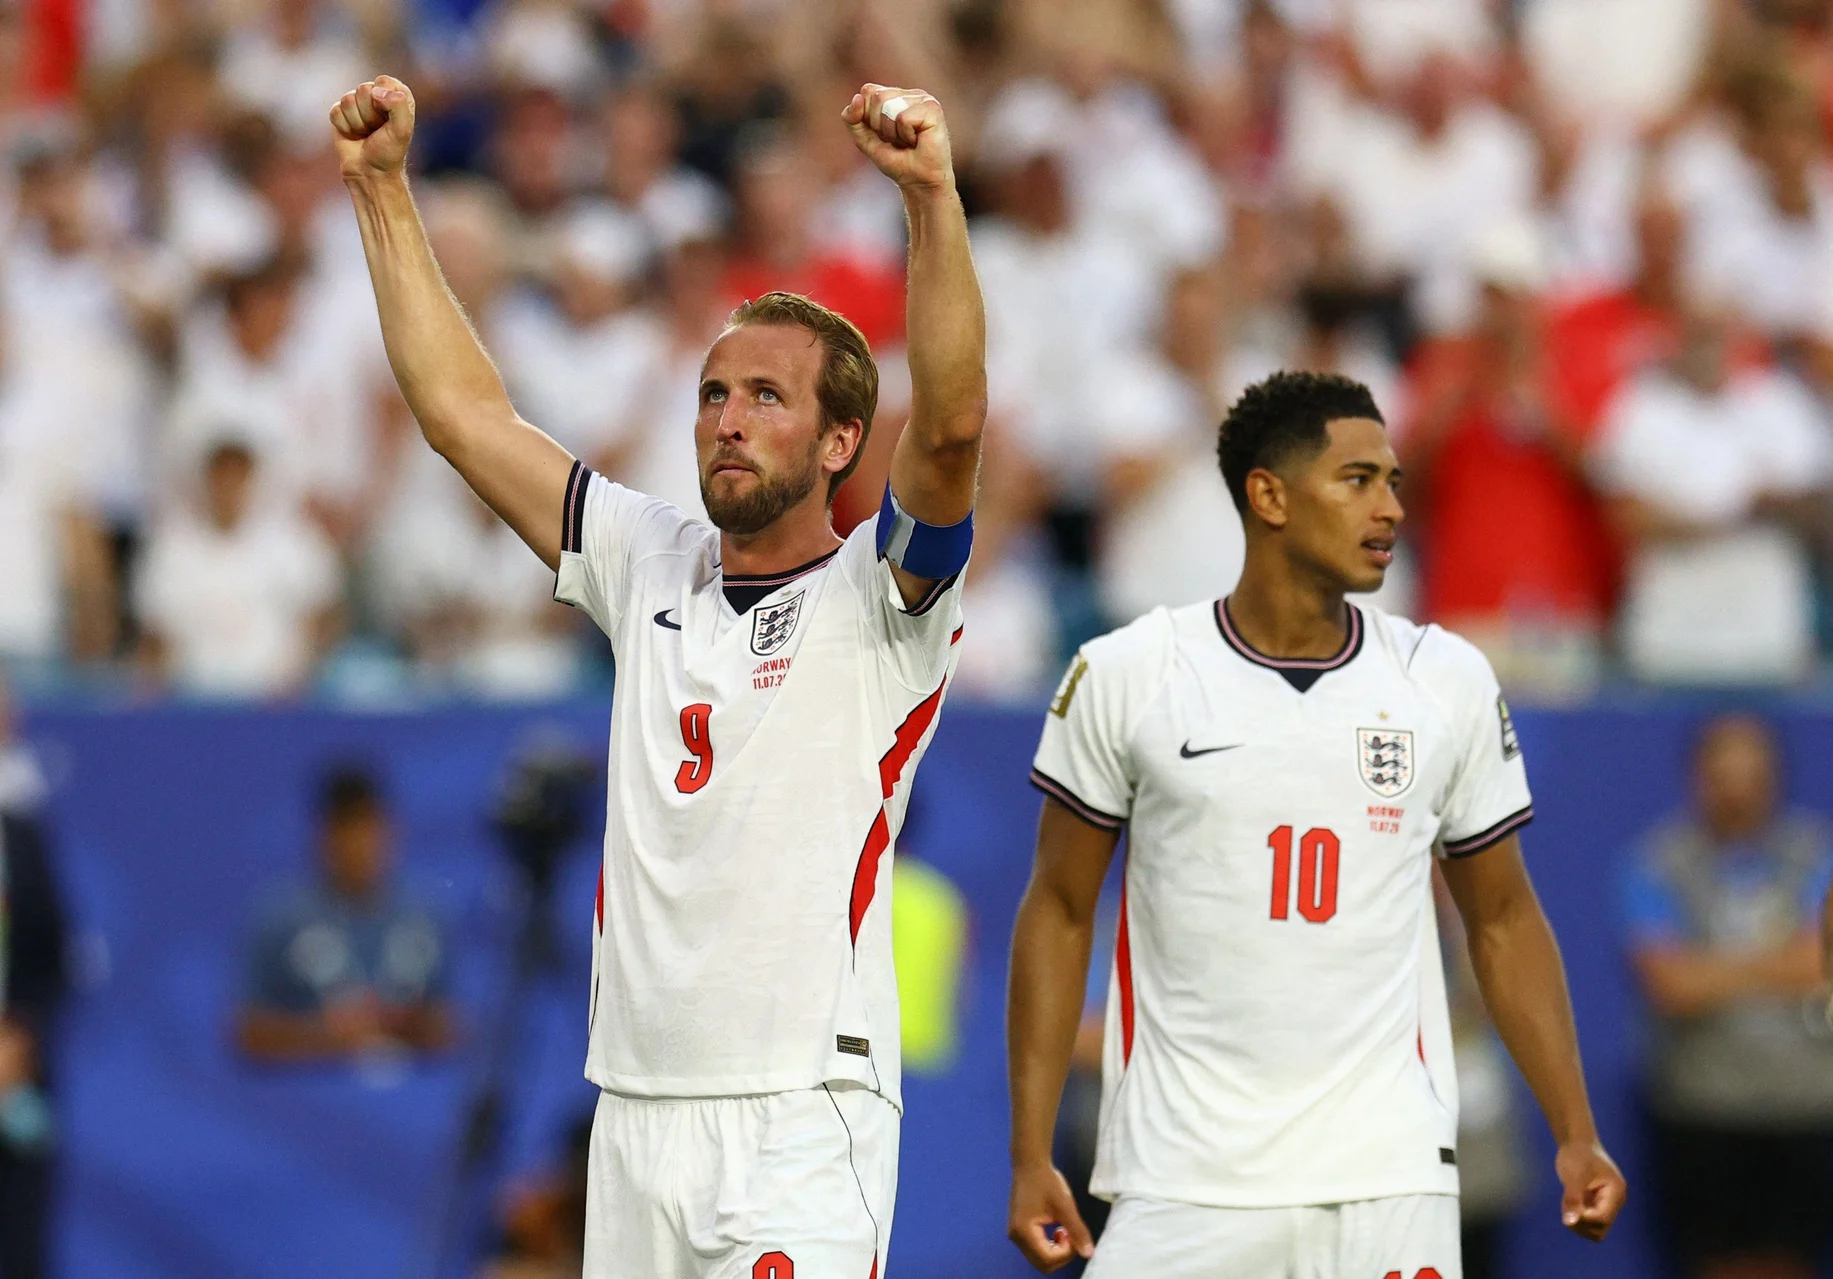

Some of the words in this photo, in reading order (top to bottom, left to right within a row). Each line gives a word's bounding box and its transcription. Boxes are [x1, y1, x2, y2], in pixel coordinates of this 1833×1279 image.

[753, 674, 786, 690] 11.07.2
[674, 703, 713, 794] 9
[1267, 825, 1340, 924] 10
